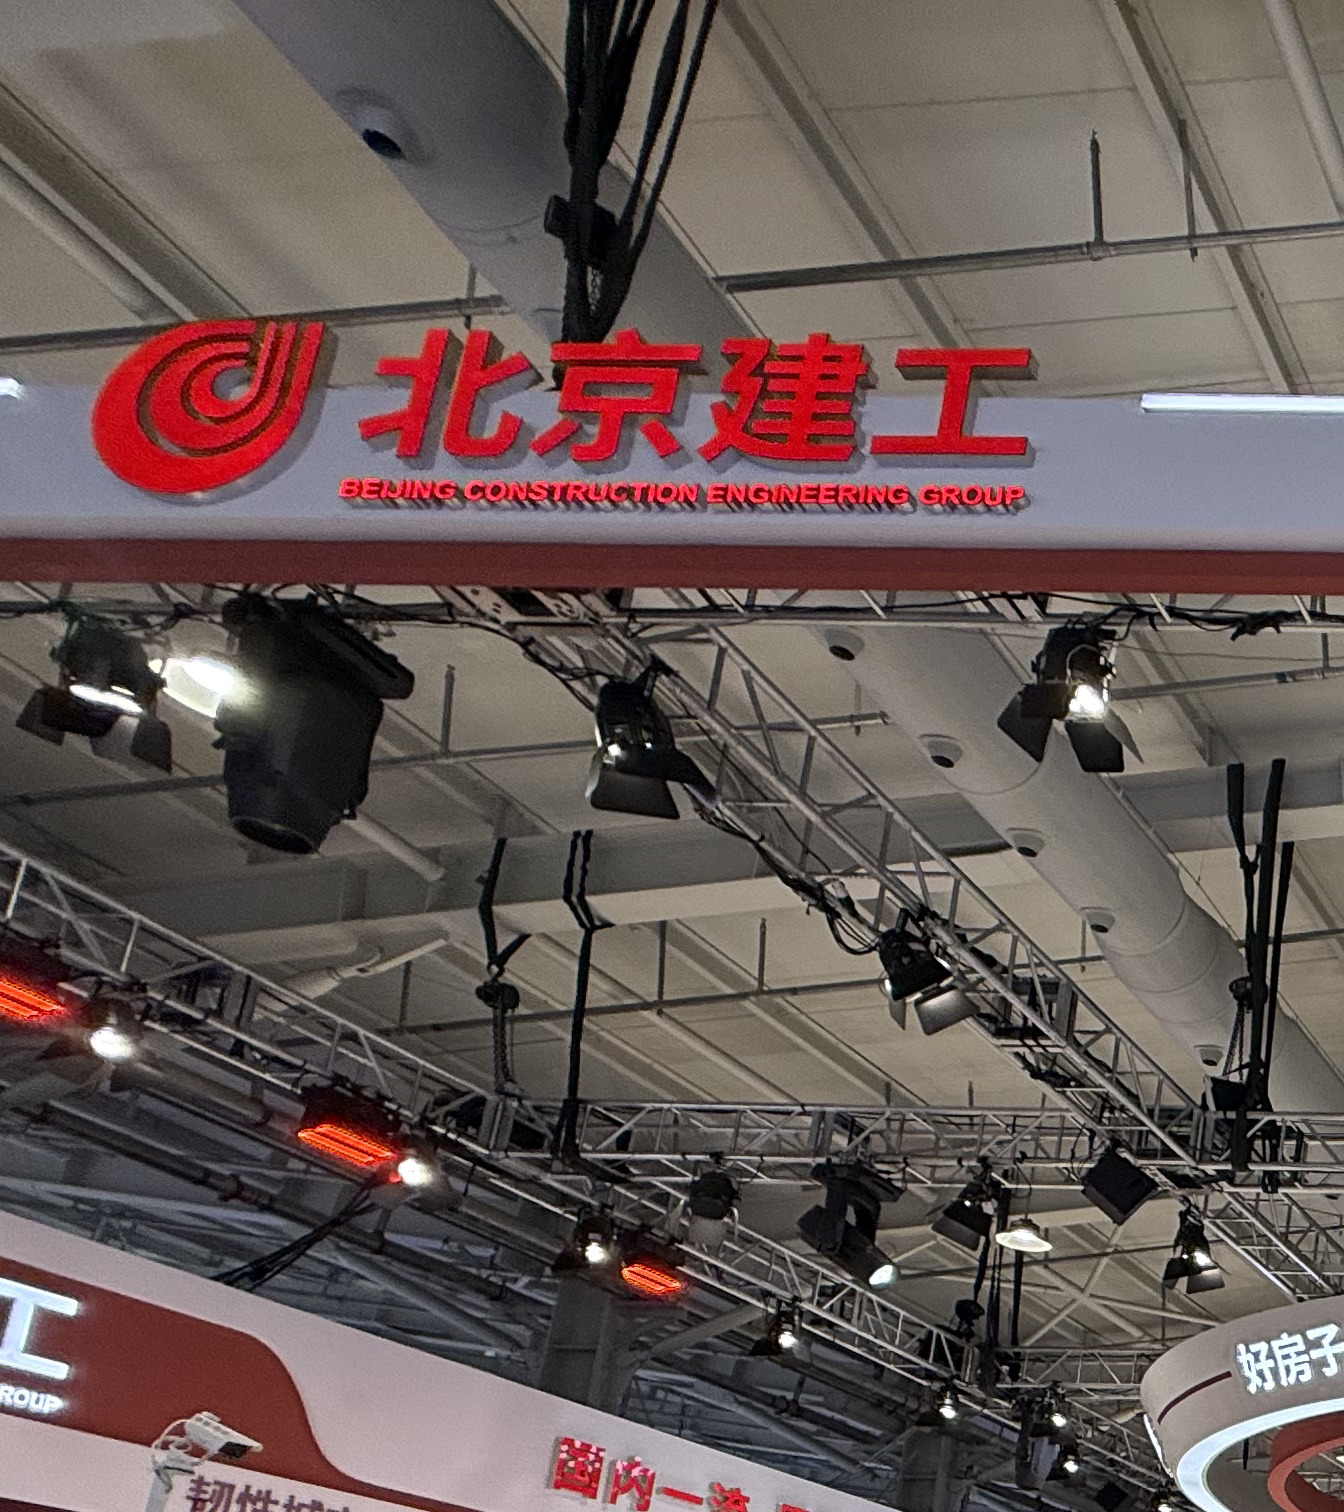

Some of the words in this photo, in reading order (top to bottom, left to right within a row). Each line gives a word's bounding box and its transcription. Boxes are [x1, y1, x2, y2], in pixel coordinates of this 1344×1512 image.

[358, 327, 1033, 463] 北京建工
[338, 478, 457, 502] BEIJING
[464, 480, 699, 504] CONSTRUCTION
[706, 482, 910, 506] ENGINEERING
[919, 484, 1026, 508] GROUP
[0, 1383, 64, 1414] ROUP
